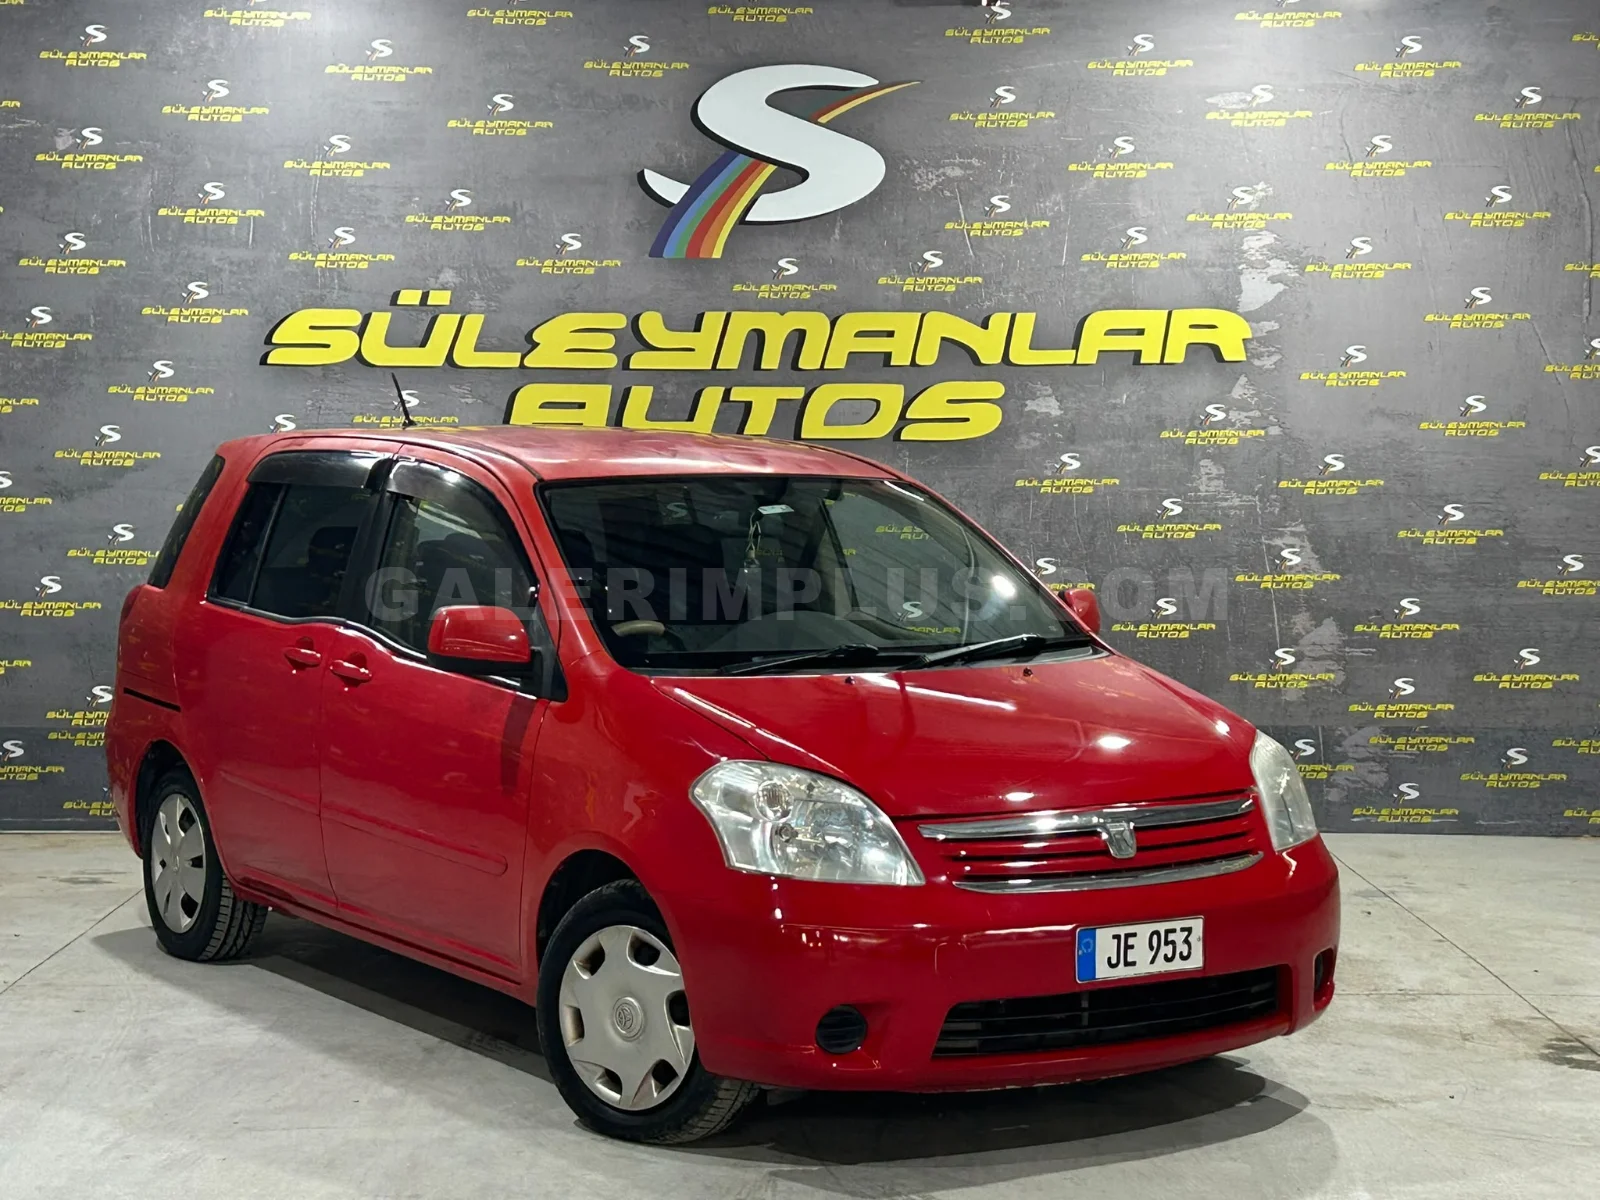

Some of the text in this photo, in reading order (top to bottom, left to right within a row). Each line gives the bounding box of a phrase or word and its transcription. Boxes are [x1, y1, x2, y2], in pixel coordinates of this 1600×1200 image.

[468, 9, 573, 19] SÜLEYMANLAR
[707, 6, 813, 16] SÜLEYMANLAR
[1235, 10, 1341, 21] SÜLEYMANLAR
[229, 18, 285, 27] AUTOS
[493, 18, 548, 26] AUTOS
[732, 15, 787, 23] AUTOS
[945, 26, 1051, 37] SÜLEYMANLAR
[40, 50, 147, 60] SÜLEYMANLAR
[65, 60, 120, 68] AUTOS
[584, 60, 689, 70] SÜLEYMANLAR
[1088, 59, 1192, 69] SÜLEYMANLAR
[1355, 60, 1461, 71] SÜLEYMANLAR
[353, 74, 408, 82] AUTOS
[1380, 70, 1435, 78] AUTOS
[162, 105, 268, 115] SÜLEYMANLAR
[950, 111, 1055, 121] SÜLEYMANLAR
[1206, 110, 1312, 121] SÜLEYMANLAR
[1474, 111, 1581, 122] SÜLEYMANLAR
[448, 119, 553, 129] SÜLEYMANLAR
[975, 120, 1030, 128] AUTOS
[1499, 121, 1554, 129] AUTOS
[642, 64, 886, 222] S
[35, 152, 142, 163] SÜLEYMANLAR
[284, 160, 389, 170] SÜLEYMANLAR
[1068, 161, 1173, 171] SÜLEYMANLAR
[1325, 159, 1432, 170] SÜLEYMANLAR
[1350, 170, 1405, 178] AUTOS
[158, 207, 264, 217] SÜLEYMANLAR
[1186, 212, 1292, 222] SÜLEYMANLAR
[1444, 210, 1551, 220] SÜLEYMANLAR
[405, 214, 511, 224] SÜLEYMANLAR
[1469, 220, 1524, 228] AUTOS
[944, 219, 1050, 230] SÜLEYMANLAR
[19, 256, 125, 267] SÜLEYMANLAR
[289, 251, 394, 262] SÜLEYMANLAR
[1081, 251, 1184, 262] SÜLEYMANLAR
[516, 258, 621, 268] SÜLEYMANLAR
[1106, 261, 1161, 269] AUTOS
[1304, 261, 1412, 272] SÜLEYMANLAR
[44, 267, 99, 275] AUTOS
[1329, 271, 1384, 280] AUTOS
[877, 275, 983, 285] SÜLEYMANLAR
[732, 282, 836, 292] SÜLEYMANLAR
[902, 285, 957, 293] AUTOS
[757, 292, 812, 300] AUTOS
[141, 306, 248, 316] SÜLEYMANLAR
[166, 316, 221, 324] AUTOS
[1424, 311, 1531, 322] SÜLEYMANLAR
[268, 289, 1251, 369] SÜLEYMANLAR
[1449, 321, 1504, 329] AUTOS
[1300, 369, 1407, 380] SÜLEYMANLAR
[1325, 379, 1380, 387] AUTOS
[108, 385, 214, 395] SÜLEYMANLAR
[509, 381, 1005, 441] AUTOS
[353, 413, 458, 424] SÜLEYANLAR
[1419, 420, 1526, 430] SÜLEYMANLAR
[1160, 428, 1265, 438] SÜLEYMANLAR
[1444, 429, 1499, 437] AUTOS
[1185, 438, 1240, 446] AUTOS
[55, 448, 160, 459] SÜLEYMANLAR
[80, 459, 135, 468] AUTOS
[1016, 476, 1120, 487] SÜLEYMANLAR
[1277, 478, 1384, 489] SÜLEYMANLAR
[1116, 522, 1222, 532] SÜLEYMANLAR
[1397, 528, 1504, 538] SÜLEYMANLAR
[1422, 537, 1477, 545] AUTOS
[93, 557, 148, 566] AUTOS
[1234, 572, 1341, 583] SÜLEYMANLAR
[1259, 581, 1314, 590] AUTOS
[1542, 587, 1596, 596] AUTOS
[20, 609, 75, 617] AUTOS
[1111, 621, 1216, 632] SÜLEYMANLAR
[1353, 622, 1461, 632] SÜLEYMANLAR
[1230, 671, 1336, 682] SÜLEYMANLAR
[1472, 672, 1579, 683] SÜLEYMANLAR
[1255, 681, 1310, 689] AUTOS
[1348, 702, 1455, 712] SÜLEYMANLAR
[1373, 712, 1428, 720] AUTOS
[1369, 735, 1474, 745] SÜLEYMANLAR
[1461, 772, 1567, 782] SÜLEYMANLAR
[1353, 806, 1457, 816] SÜLEYMANLAR
[1107, 926, 1193, 969] JE 953
